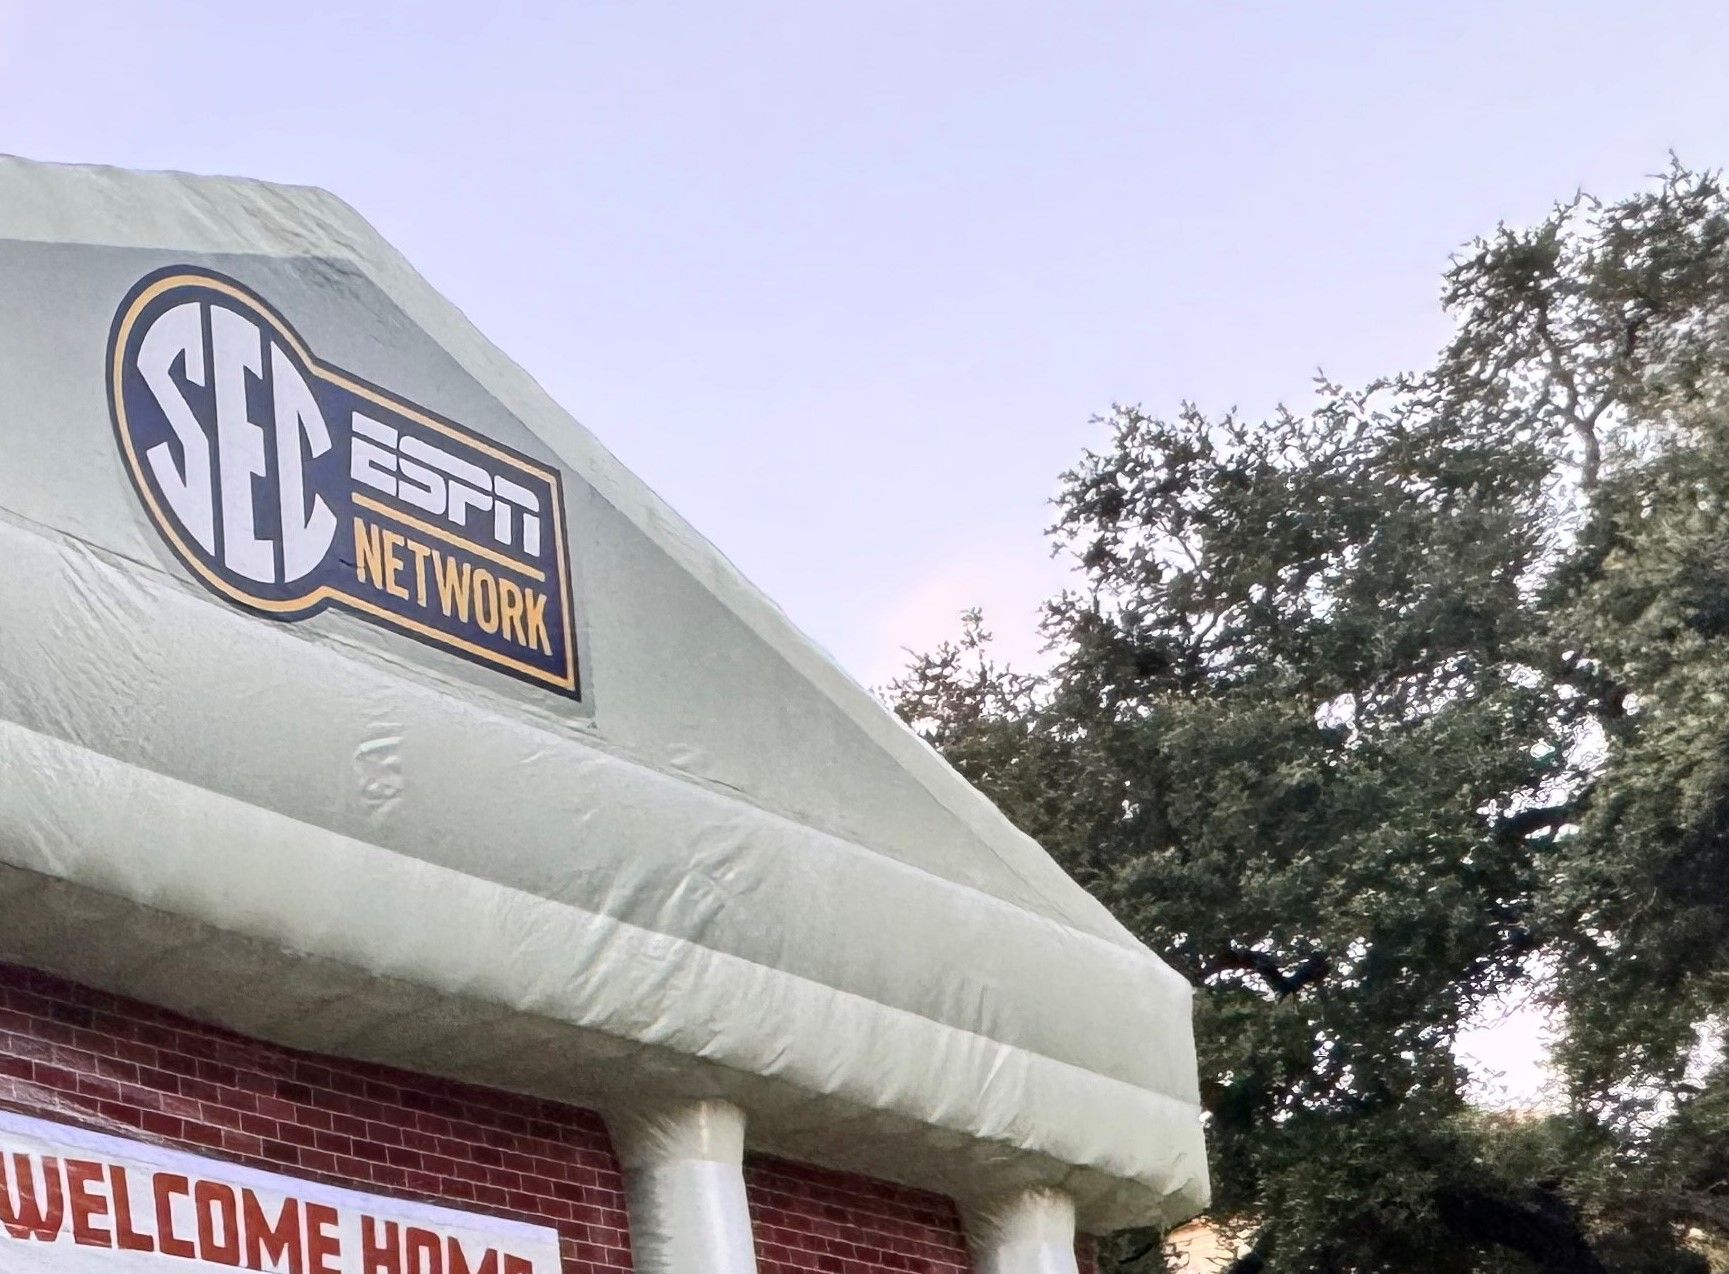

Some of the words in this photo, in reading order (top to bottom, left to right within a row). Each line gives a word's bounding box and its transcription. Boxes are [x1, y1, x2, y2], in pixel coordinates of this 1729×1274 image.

[137, 302, 337, 583] SEC
[351, 411, 540, 557] ESPN
[354, 517, 552, 656] NETWORK
